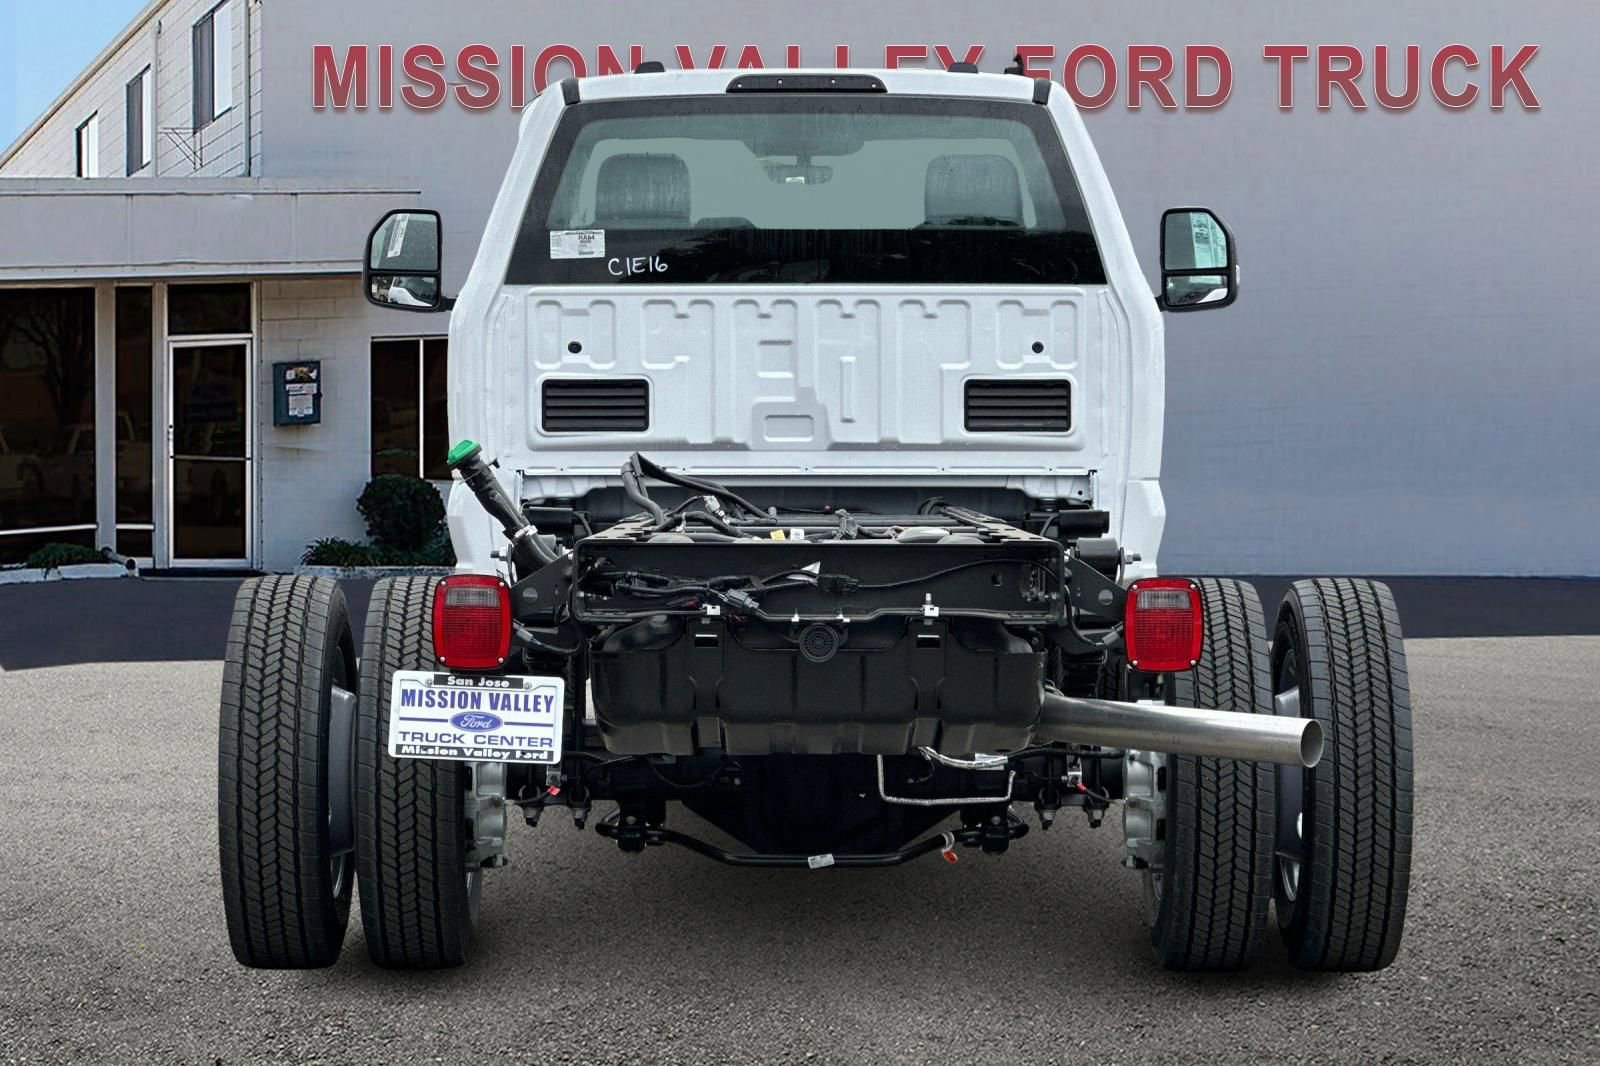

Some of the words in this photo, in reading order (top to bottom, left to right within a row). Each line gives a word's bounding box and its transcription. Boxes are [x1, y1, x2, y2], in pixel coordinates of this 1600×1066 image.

[1015, 44, 1233, 108] FORD
[1263, 44, 1540, 109] TRUCK
[447, 676, 474, 687] San
[477, 677, 510, 688] Jose
[401, 688, 481, 710] MISSION
[488, 692, 555, 713] VALLEY
[460, 714, 493, 729] Ford
[398, 731, 466, 744] TRUCK
[473, 734, 553, 748] CENTER
[401, 745, 458, 756] Mission
[463, 747, 511, 760] Valley
[515, 750, 548, 760] Ford
